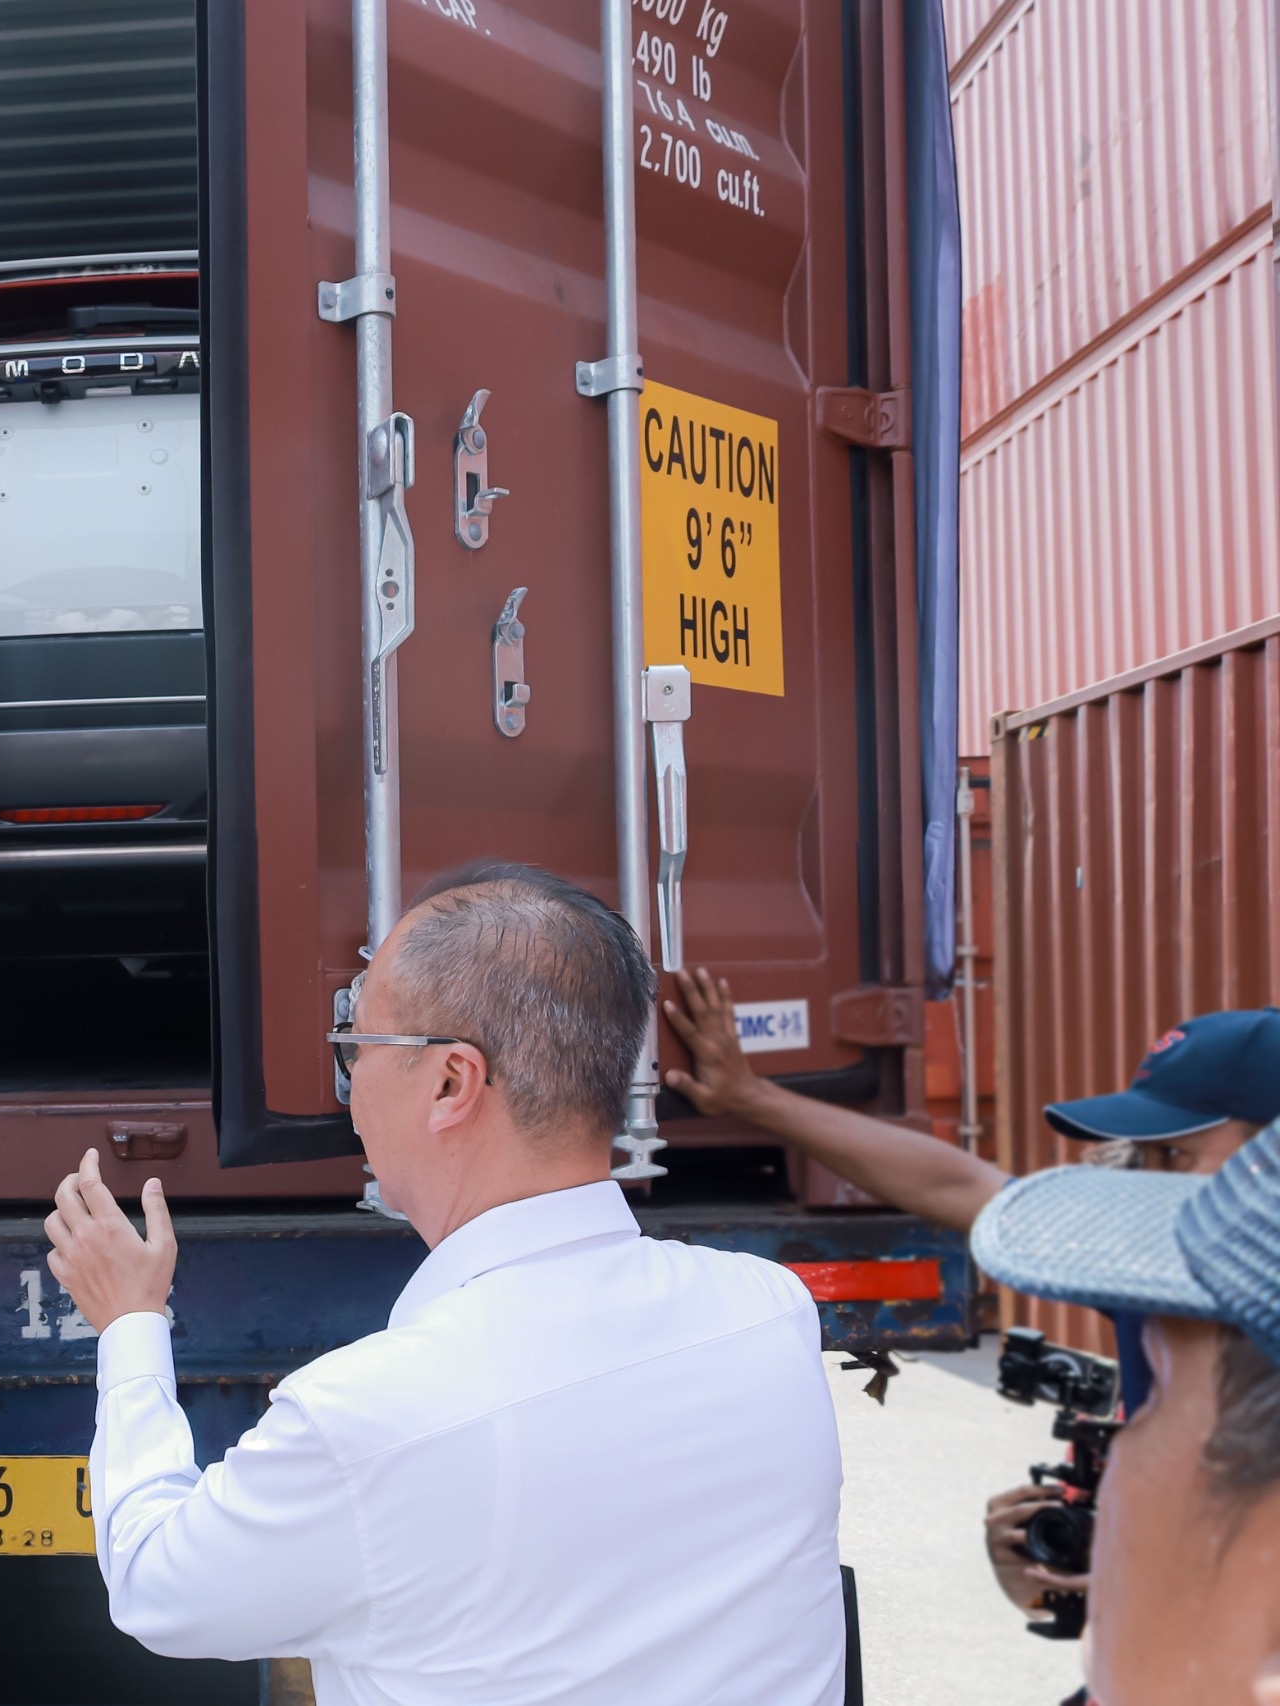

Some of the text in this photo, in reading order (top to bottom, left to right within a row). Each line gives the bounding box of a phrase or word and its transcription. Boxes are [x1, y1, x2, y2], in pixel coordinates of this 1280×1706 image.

[696, 0, 728, 58] kg
[637, 79, 696, 132] 76.4
[692, 55, 711, 102] lb
[640, 124, 765, 217] 2,700 cu.ft.
[644, 407, 774, 504] CAUTION
[679, 593, 751, 667] HIGH
